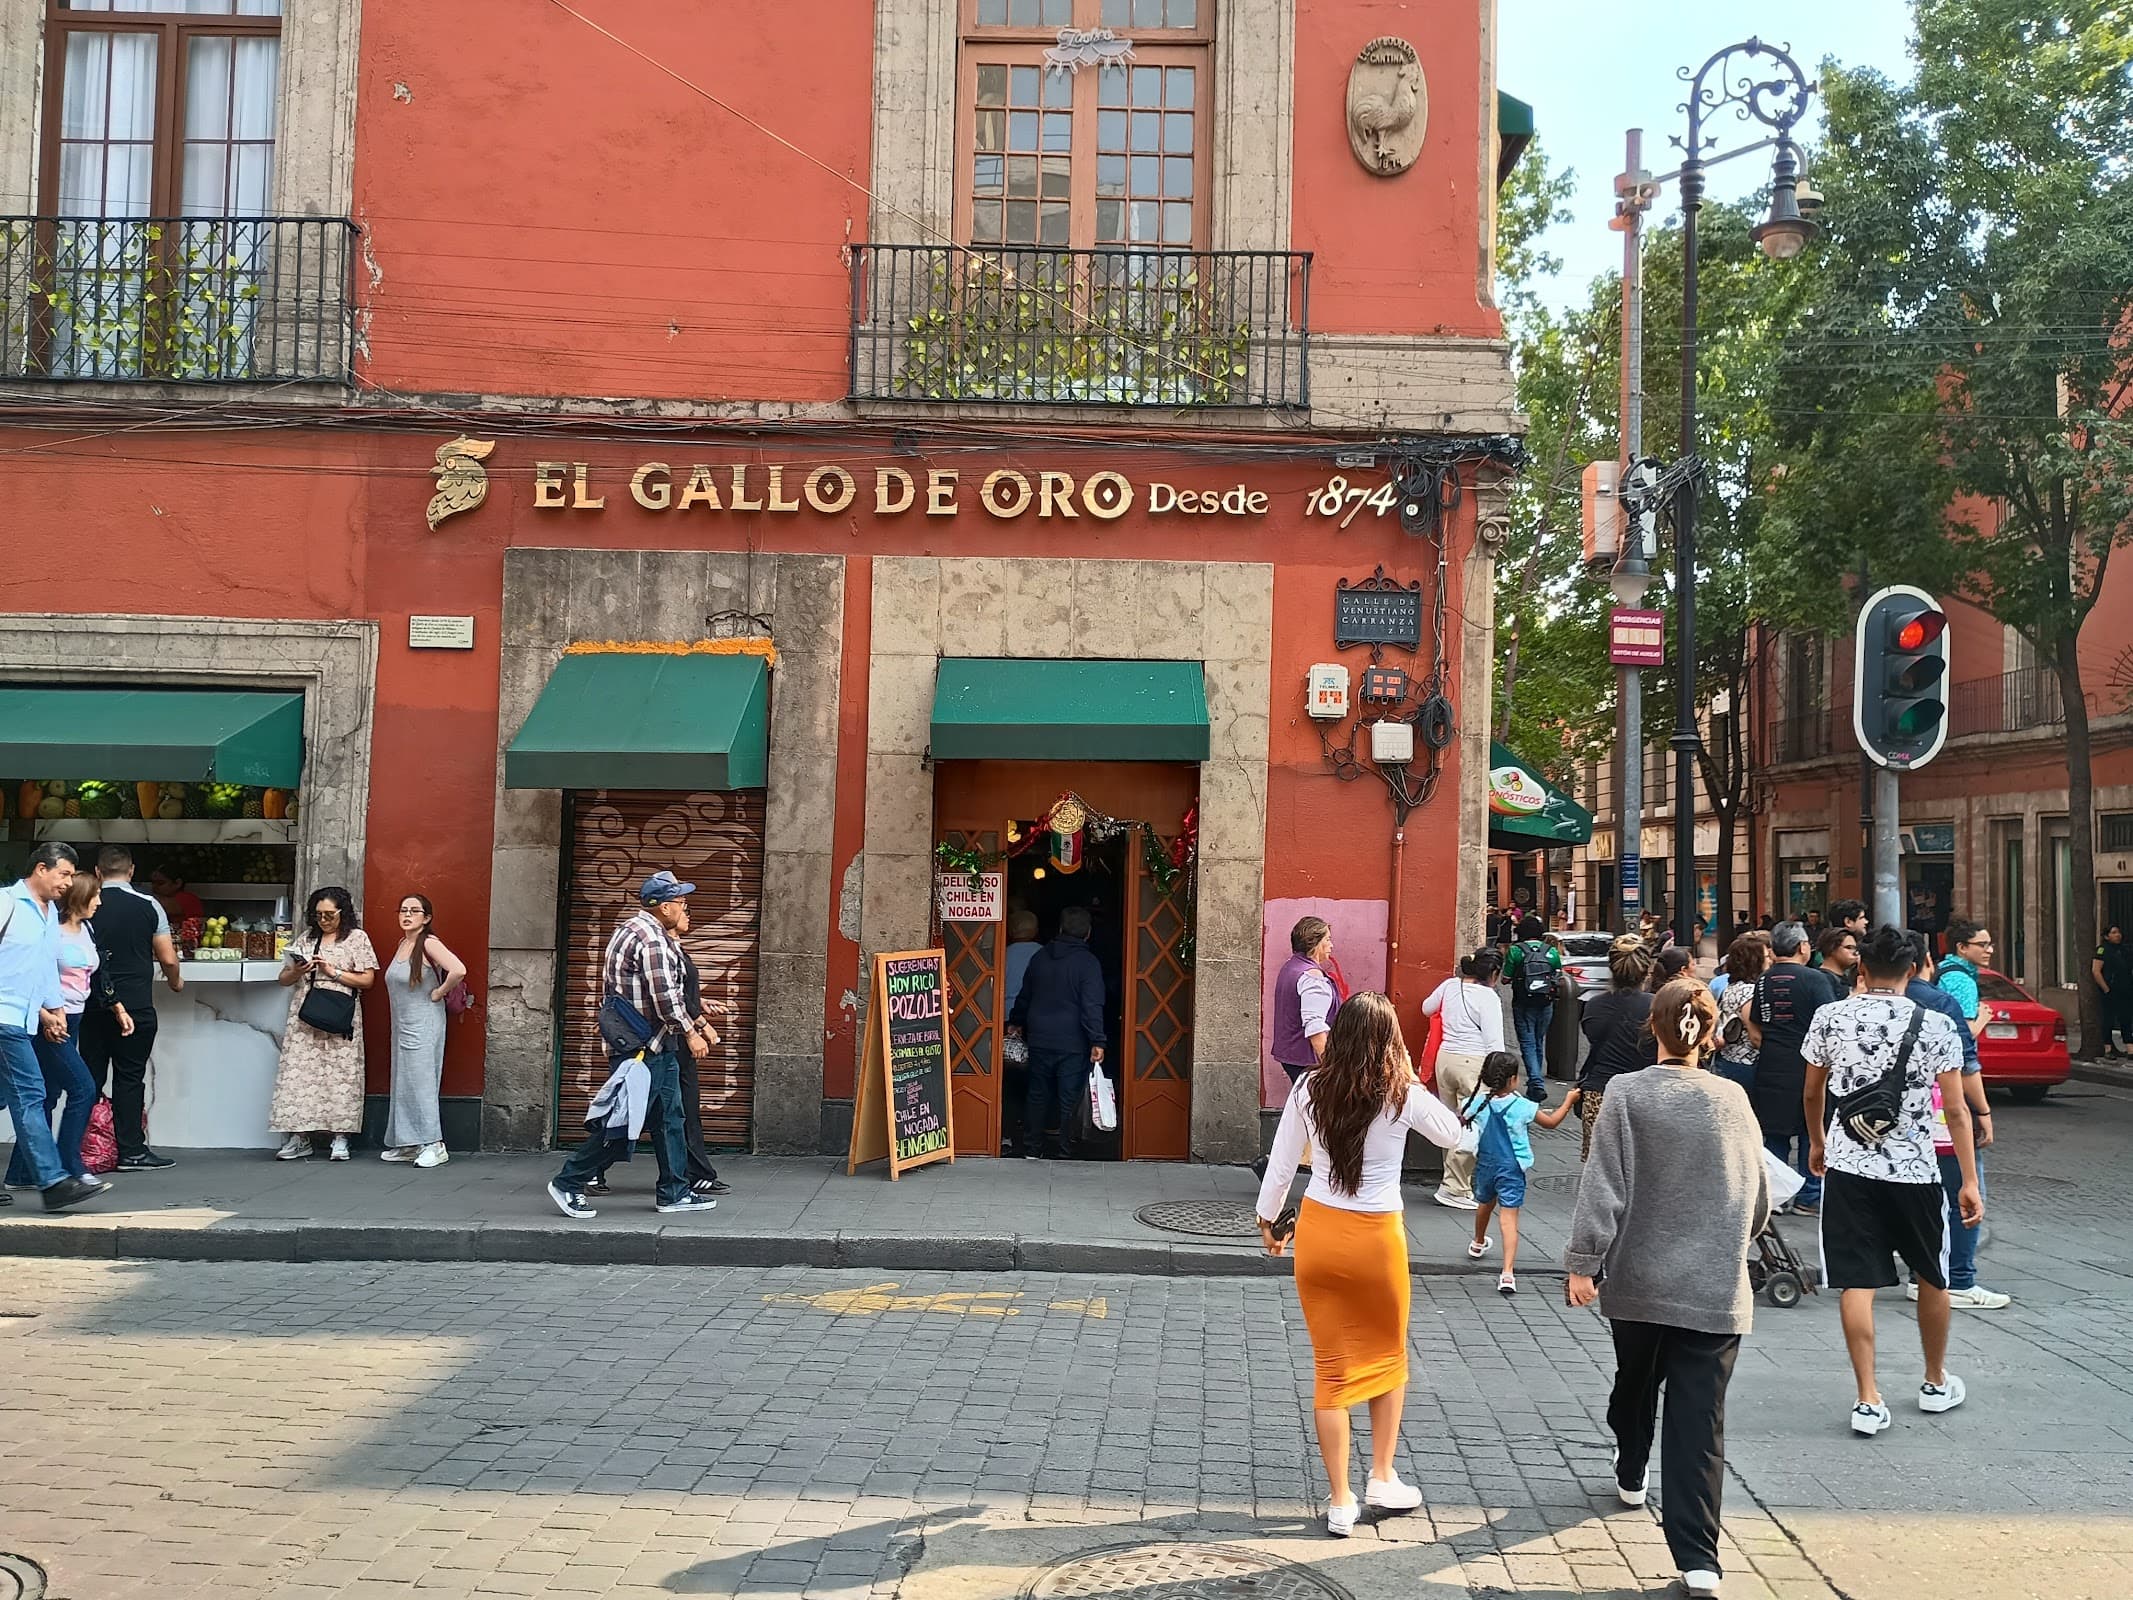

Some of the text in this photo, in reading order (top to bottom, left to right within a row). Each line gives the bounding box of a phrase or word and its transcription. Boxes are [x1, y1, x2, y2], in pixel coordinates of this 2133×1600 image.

[533, 461, 605, 509] EL
[629, 462, 857, 513] GALLO
[873, 466, 960, 515] DE
[979, 469, 1135, 519] ORO
[1149, 482, 1270, 515] Desde
[1305, 475, 1404, 529] 1874
[1342, 597, 1416, 606] CALLE DE
[1342, 607, 1415, 616] VENUSTIANO
[1341, 616, 1415, 626] CARRANZA
[1489, 789, 1541, 805] ONÓSTICOS
[943, 876, 998, 888] DELICOSO
[947, 891, 995, 903] CHILE EN
[948, 906, 992, 918] NOGADA
[889, 973, 935, 994] HOY RICO
[889, 989, 942, 1021] POZOLE
[893, 1032, 916, 1045] ERVEZA
[895, 1101, 930, 1123] CHILE EN
[904, 1114, 940, 1136] NOGADA
[896, 1127, 947, 1160] BIENVENIDOS
